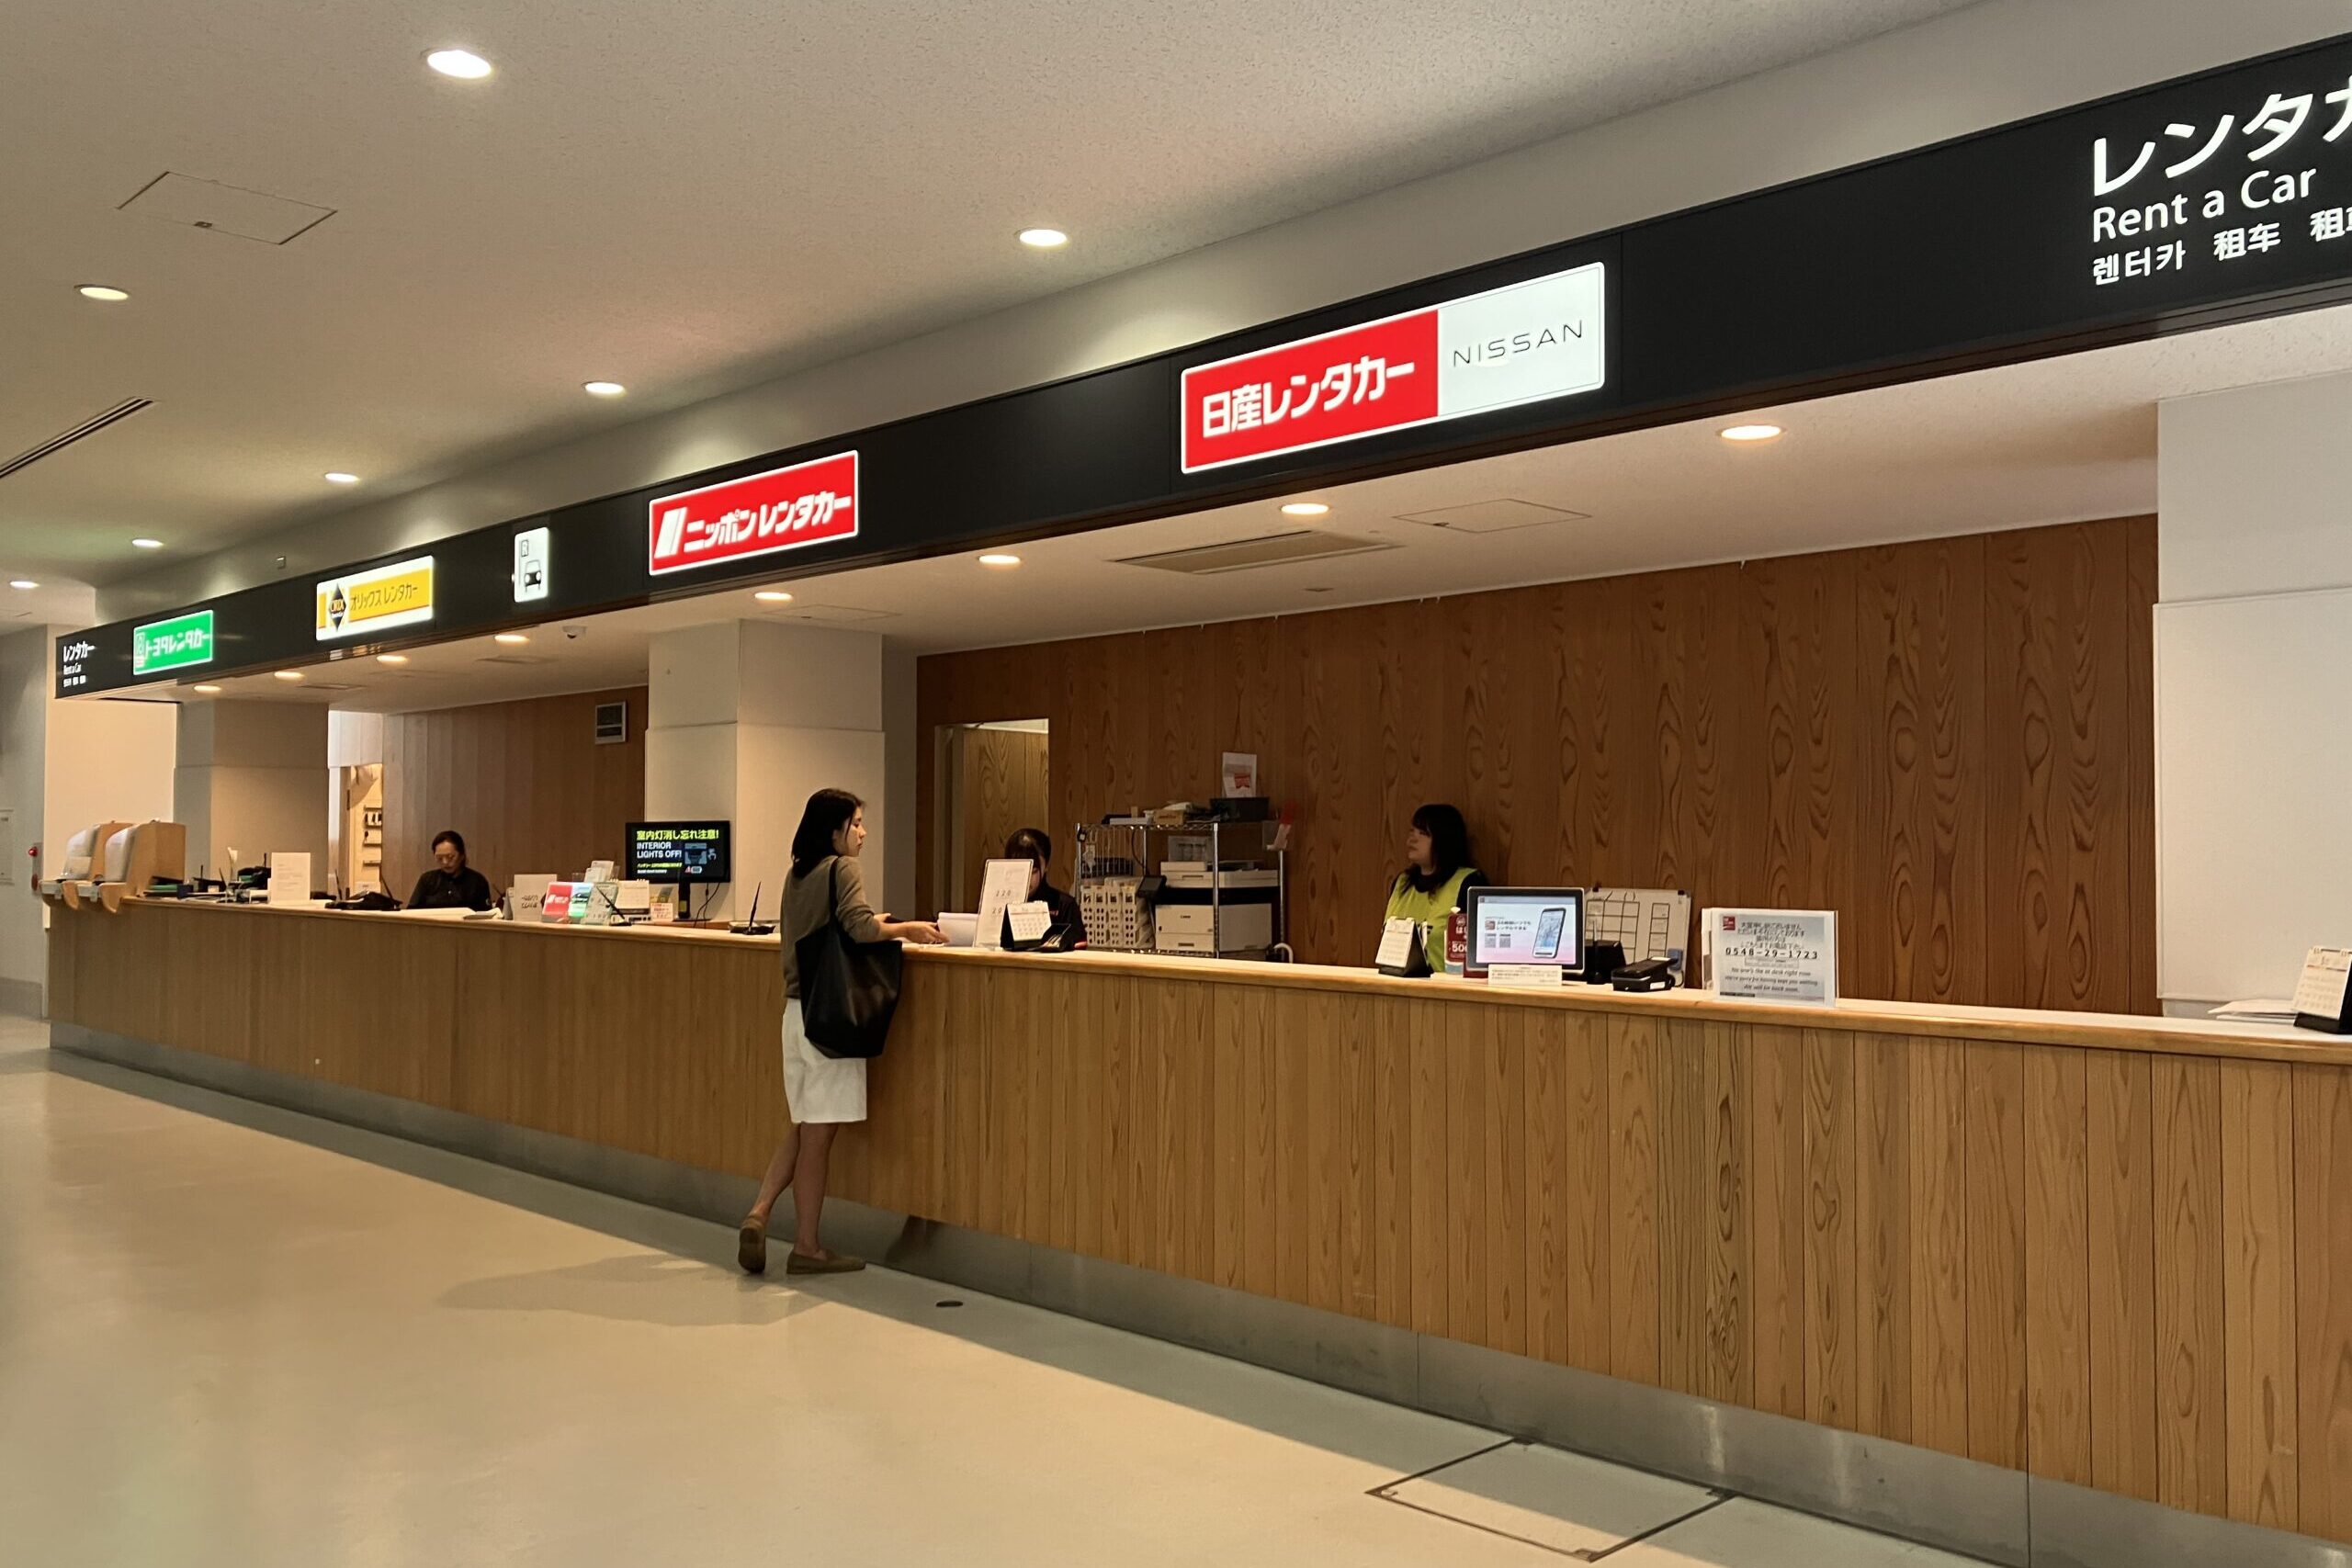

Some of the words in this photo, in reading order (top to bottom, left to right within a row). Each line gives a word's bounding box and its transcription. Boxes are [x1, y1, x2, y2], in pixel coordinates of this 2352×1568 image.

[2093, 194, 2188, 243] Rent
[2202, 190, 2224, 219] a
[2241, 168, 2317, 208] Car
[2213, 222, 2281, 261] 租车
[2310, 207, 2352, 242] 租
[2093, 240, 2186, 285] 렌터카
[1453, 320, 1583, 367] NISSAN
[1203, 355, 1415, 438] 日産レンタカー
[684, 491, 852, 552] ニッポンレンタカー
[63, 640, 96, 662] レンタカー
[146, 628, 209, 660] トヨタレンタカー
[637, 841, 672, 850] INTERIOR
[637, 850, 663, 858] LIGHTS
[1725, 947, 1818, 960] 0548-29-1723
